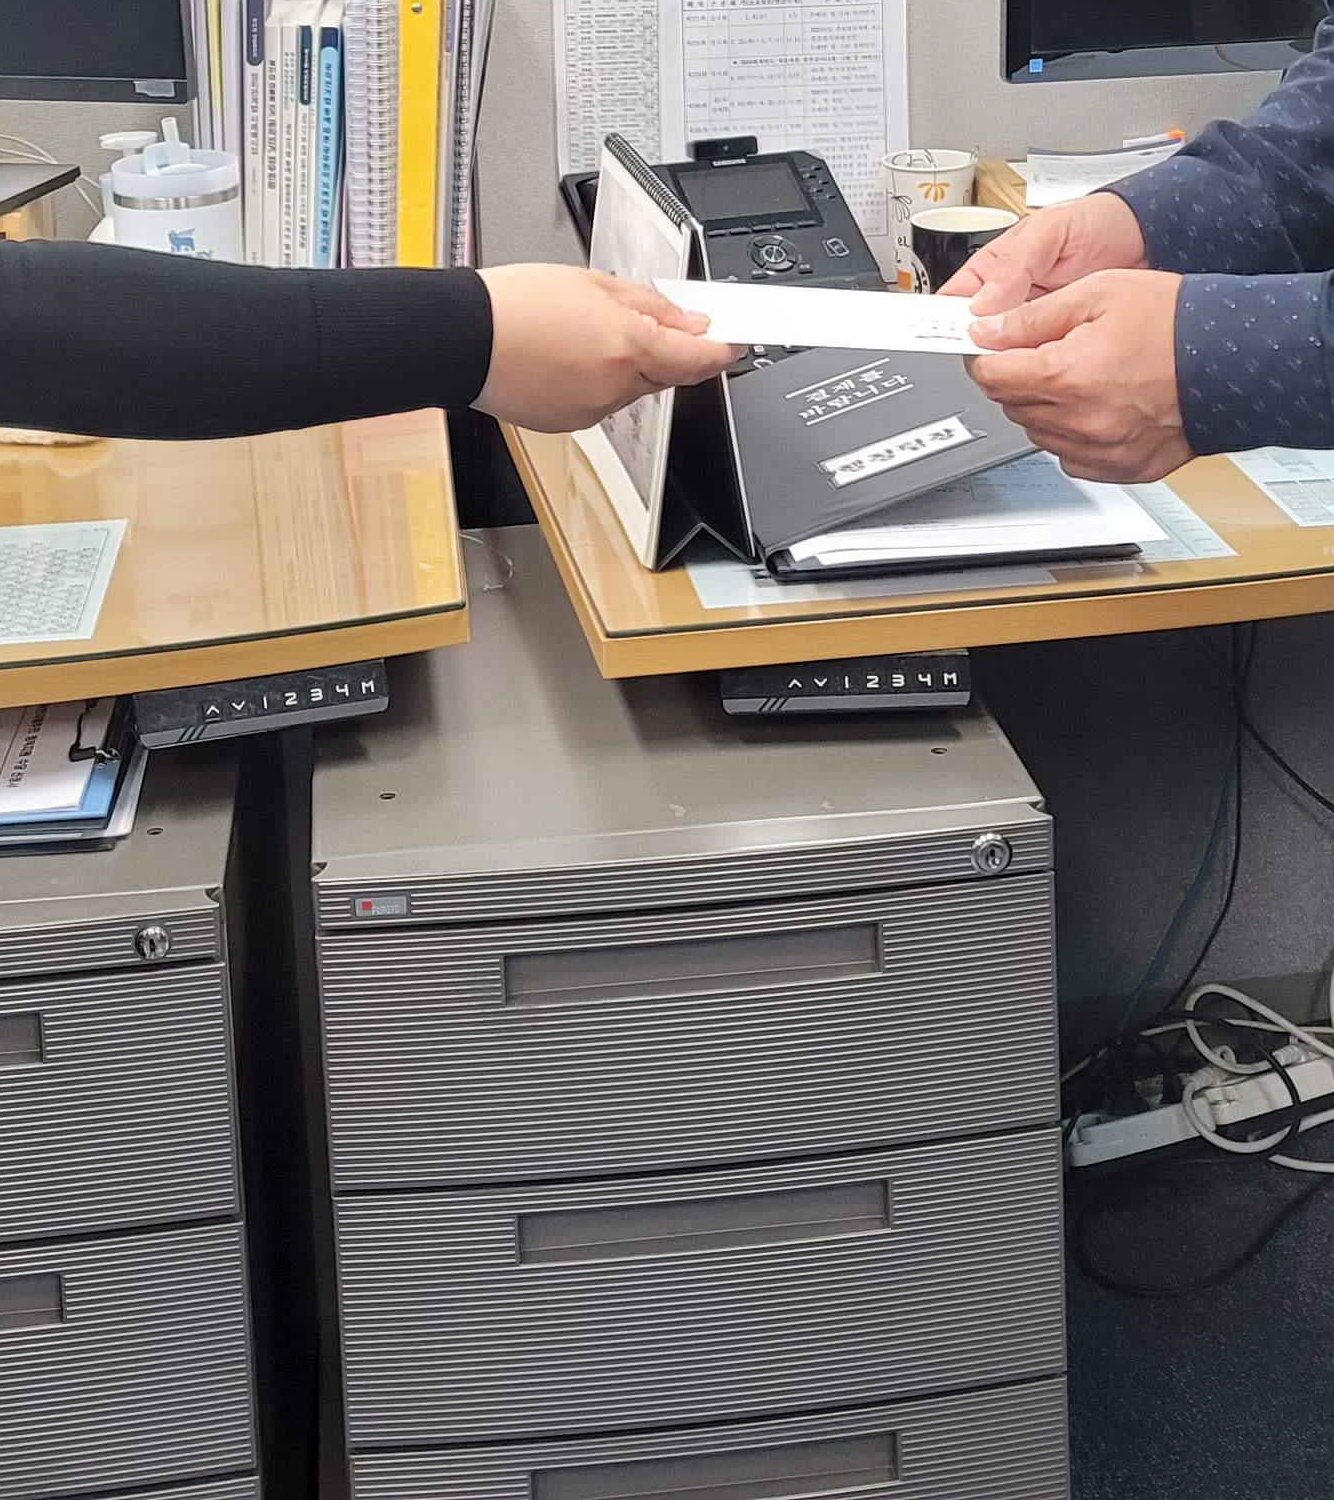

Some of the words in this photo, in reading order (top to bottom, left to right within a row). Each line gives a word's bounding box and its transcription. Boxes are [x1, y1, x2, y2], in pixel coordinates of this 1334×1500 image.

[798, 374, 908, 419] 바랍니다
[866, 675, 879, 688] 2
[892, 674, 905, 687] 3
[918, 673, 931, 686] 4
[943, 672, 957, 685] M
[284, 692, 298, 706] 2
[310, 688, 323, 702] 3
[335, 683, 349, 697] 4
[361, 680, 375, 694] M
[371, 904, 400, 915] FURSYS
